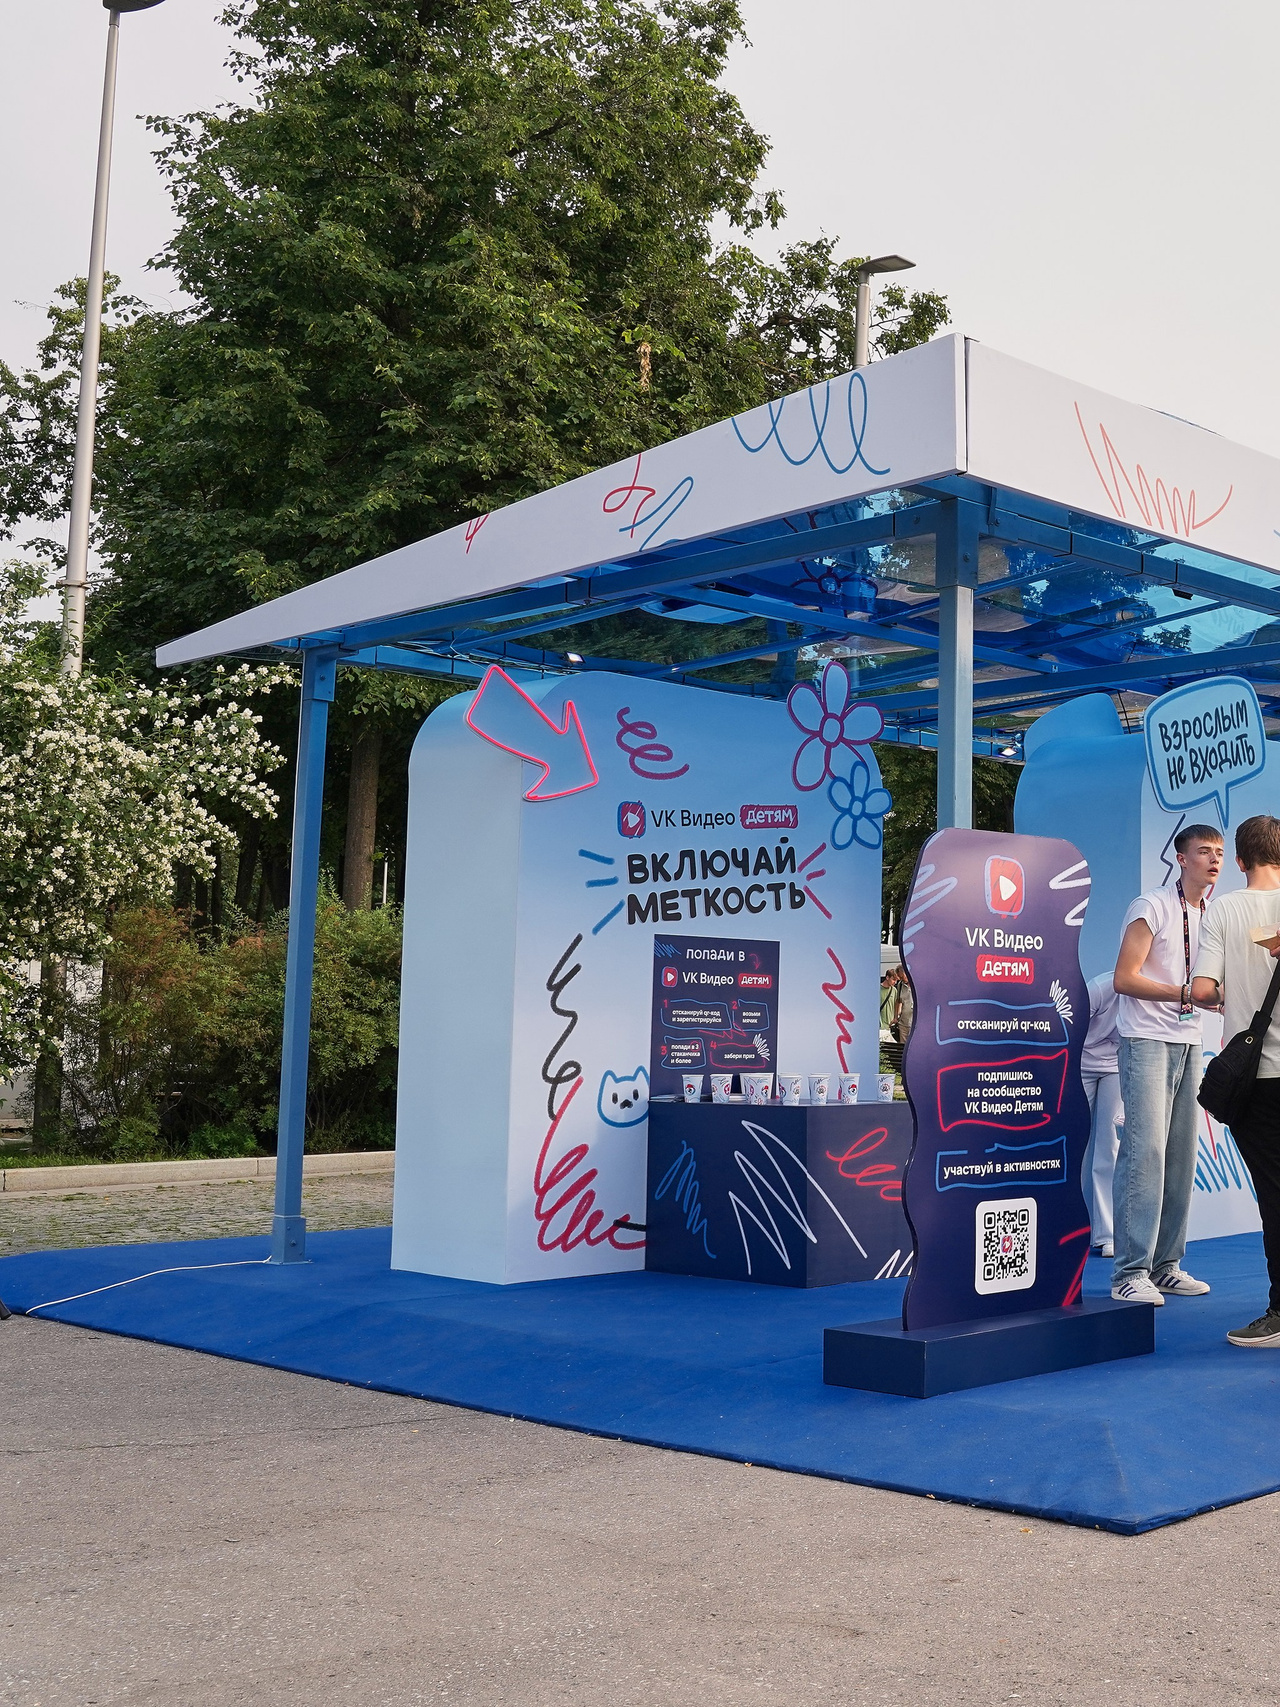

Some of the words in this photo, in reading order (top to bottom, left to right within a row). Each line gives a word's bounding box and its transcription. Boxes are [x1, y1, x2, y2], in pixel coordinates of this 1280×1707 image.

[1158, 699, 1249, 752] ВЗРОСЛЫМ
[651, 809, 676, 828] VK
[681, 809, 735, 829] Видео
[627, 836, 796, 884] ВКЛЮЧАЙ
[627, 882, 806, 925] МЕТКОСТЬ
[965, 927, 990, 947] VK
[994, 929, 1043, 952] Видео
[686, 949, 734, 961] попади
[682, 972, 698, 984] VK
[700, 973, 734, 986] Видео
[663, 1000, 668, 1008] 1
[732, 1001, 738, 1009] 2
[672, 1009, 703, 1017] отсканируй
[957, 1018, 1019, 1032] отсканируй
[1021, 1020, 1051, 1032] qr-код
[661, 1046, 667, 1055] 3
[710, 1041, 717, 1050] 4
[978, 1071, 1033, 1083] подпишись
[967, 1088, 979, 1097] на
[982, 1085, 1041, 1098] сообщество
[964, 1102, 979, 1114] VK
[981, 1101, 1012, 1115] Видео
[1014, 1100, 1043, 1114] Детям
[943, 1161, 993, 1179] участвуй
[996, 1164, 1002, 1173] в
[1004, 1159, 1061, 1172] активностях
